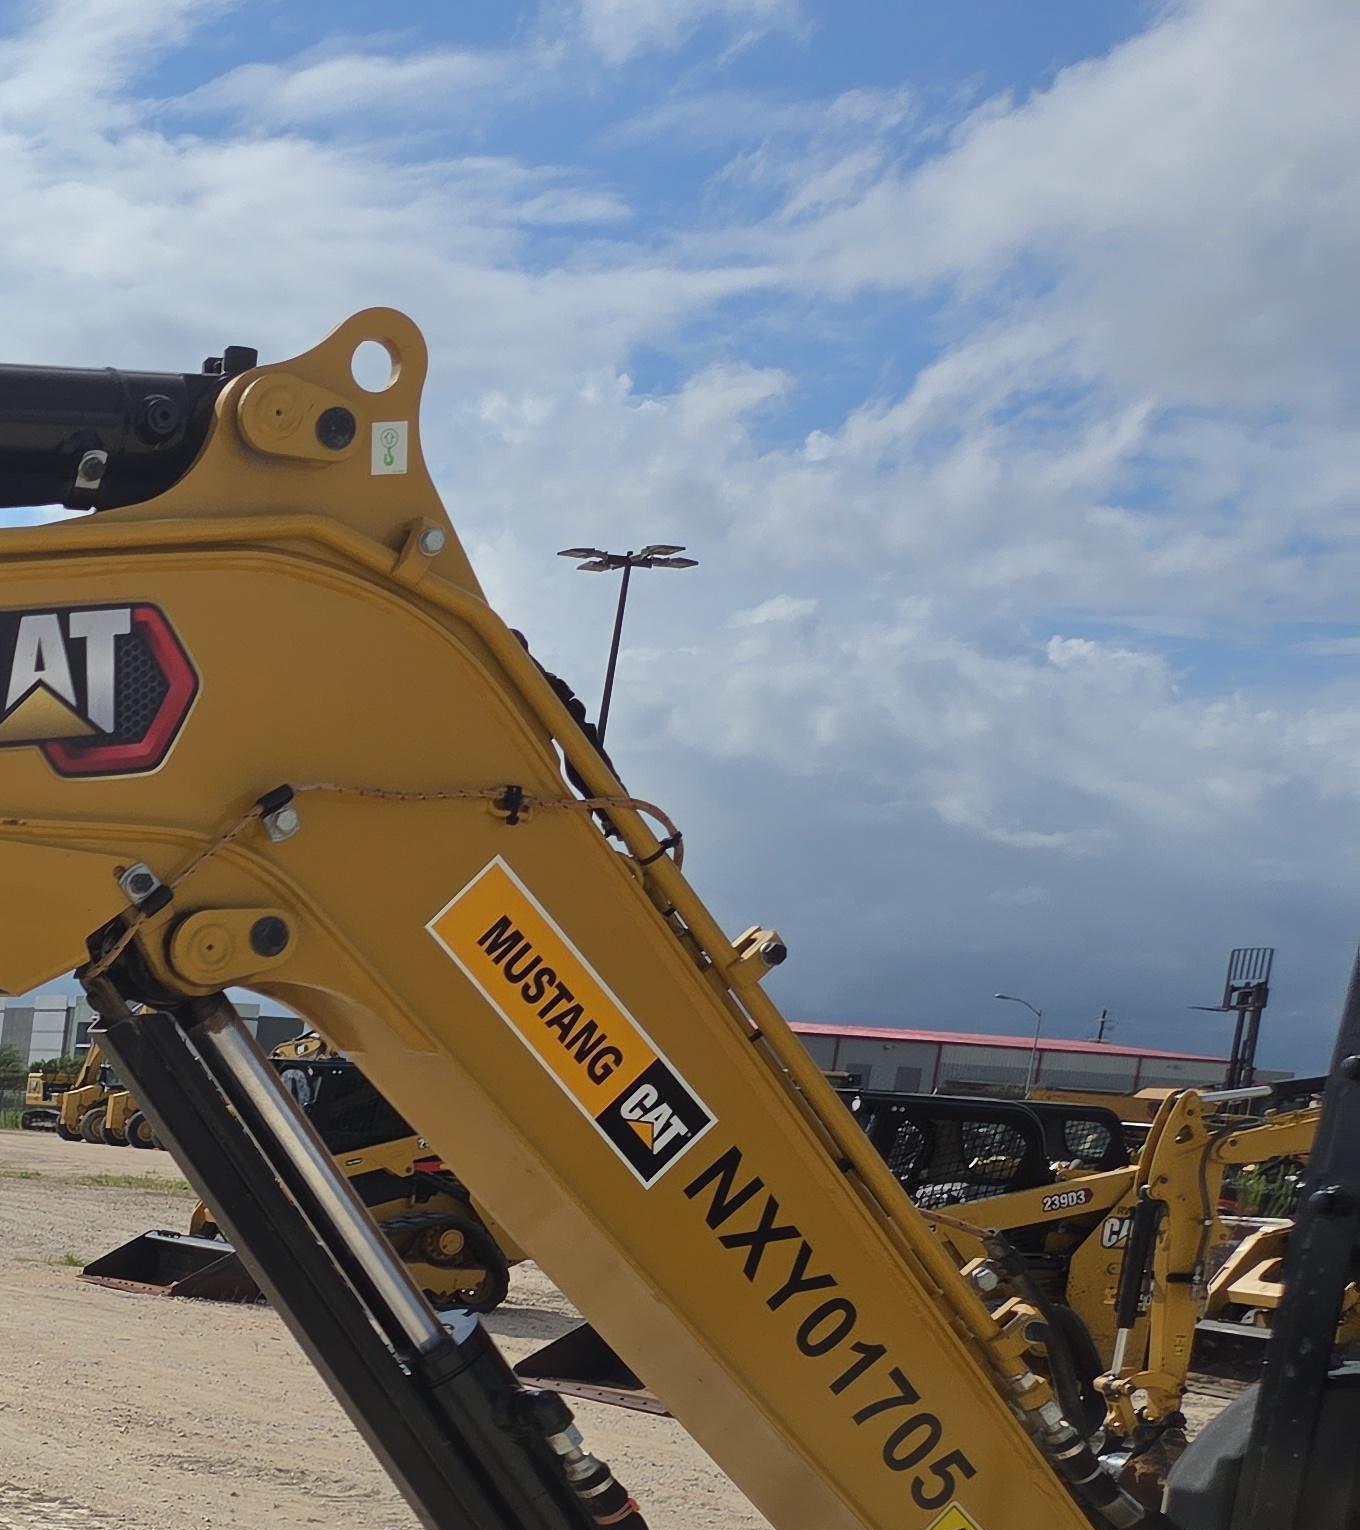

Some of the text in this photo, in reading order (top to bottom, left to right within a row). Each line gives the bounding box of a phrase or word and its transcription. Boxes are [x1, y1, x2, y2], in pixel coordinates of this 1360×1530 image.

[476, 914, 624, 1086] MUSTANG
[620, 1083, 689, 1155] CAT
[1042, 1190, 1086, 1211] 239D3
[1102, 1218, 1130, 1248] CA
[683, 1145, 977, 1510] NXY01705
